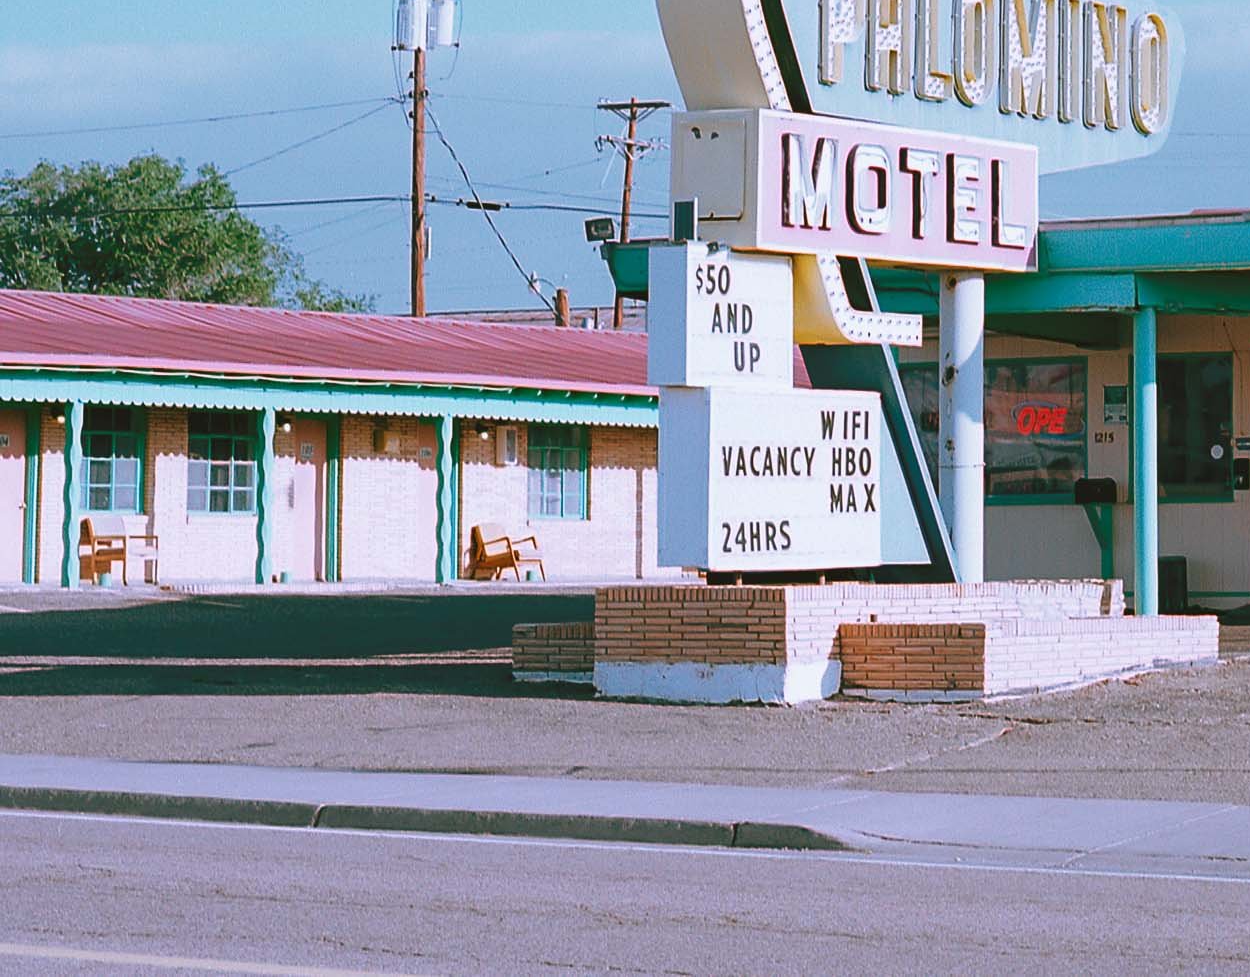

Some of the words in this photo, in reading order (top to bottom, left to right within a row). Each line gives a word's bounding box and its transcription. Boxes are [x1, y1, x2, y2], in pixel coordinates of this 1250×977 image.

[781, 133, 1029, 249] MOTEL
[696, 263, 730, 295] $50
[712, 303, 753, 334] AND
[734, 342, 760, 372] UP
[821, 411, 870, 440] WIFI
[1095, 432, 1114, 444] 1215
[722, 446, 816, 477] VACANCY
[832, 447, 872, 477] HBO
[830, 483, 876, 513] MAX
[722, 521, 791, 552] 24HRS
